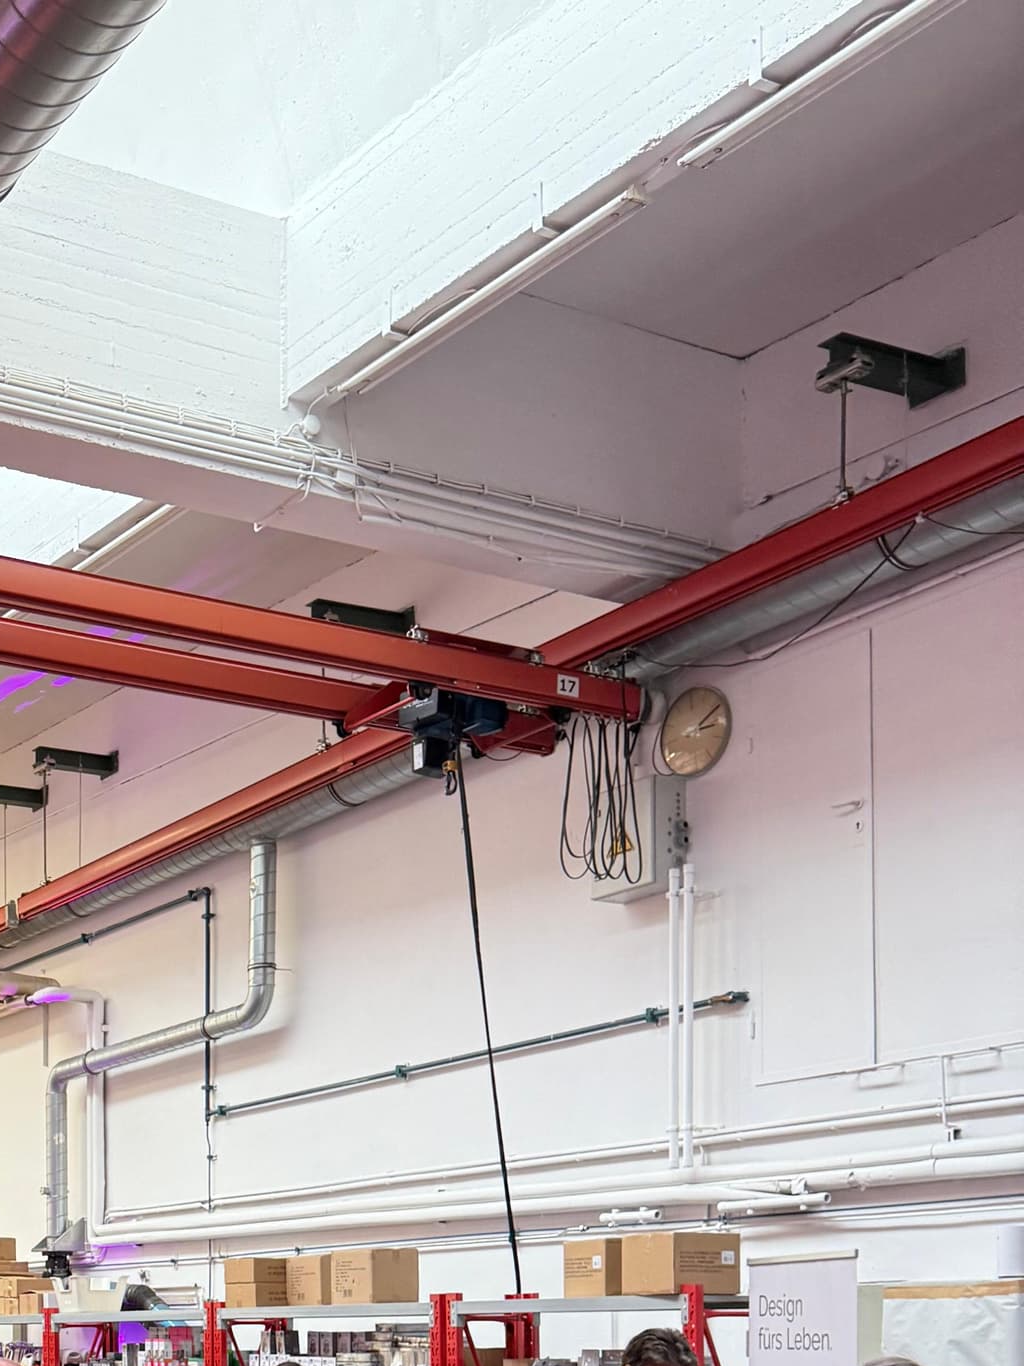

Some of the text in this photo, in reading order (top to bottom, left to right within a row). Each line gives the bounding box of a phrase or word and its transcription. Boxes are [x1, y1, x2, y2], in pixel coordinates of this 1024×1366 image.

[560, 679, 576, 693] 17
[759, 1293, 803, 1323] Design
[759, 1327, 832, 1351] fürs Leben.
